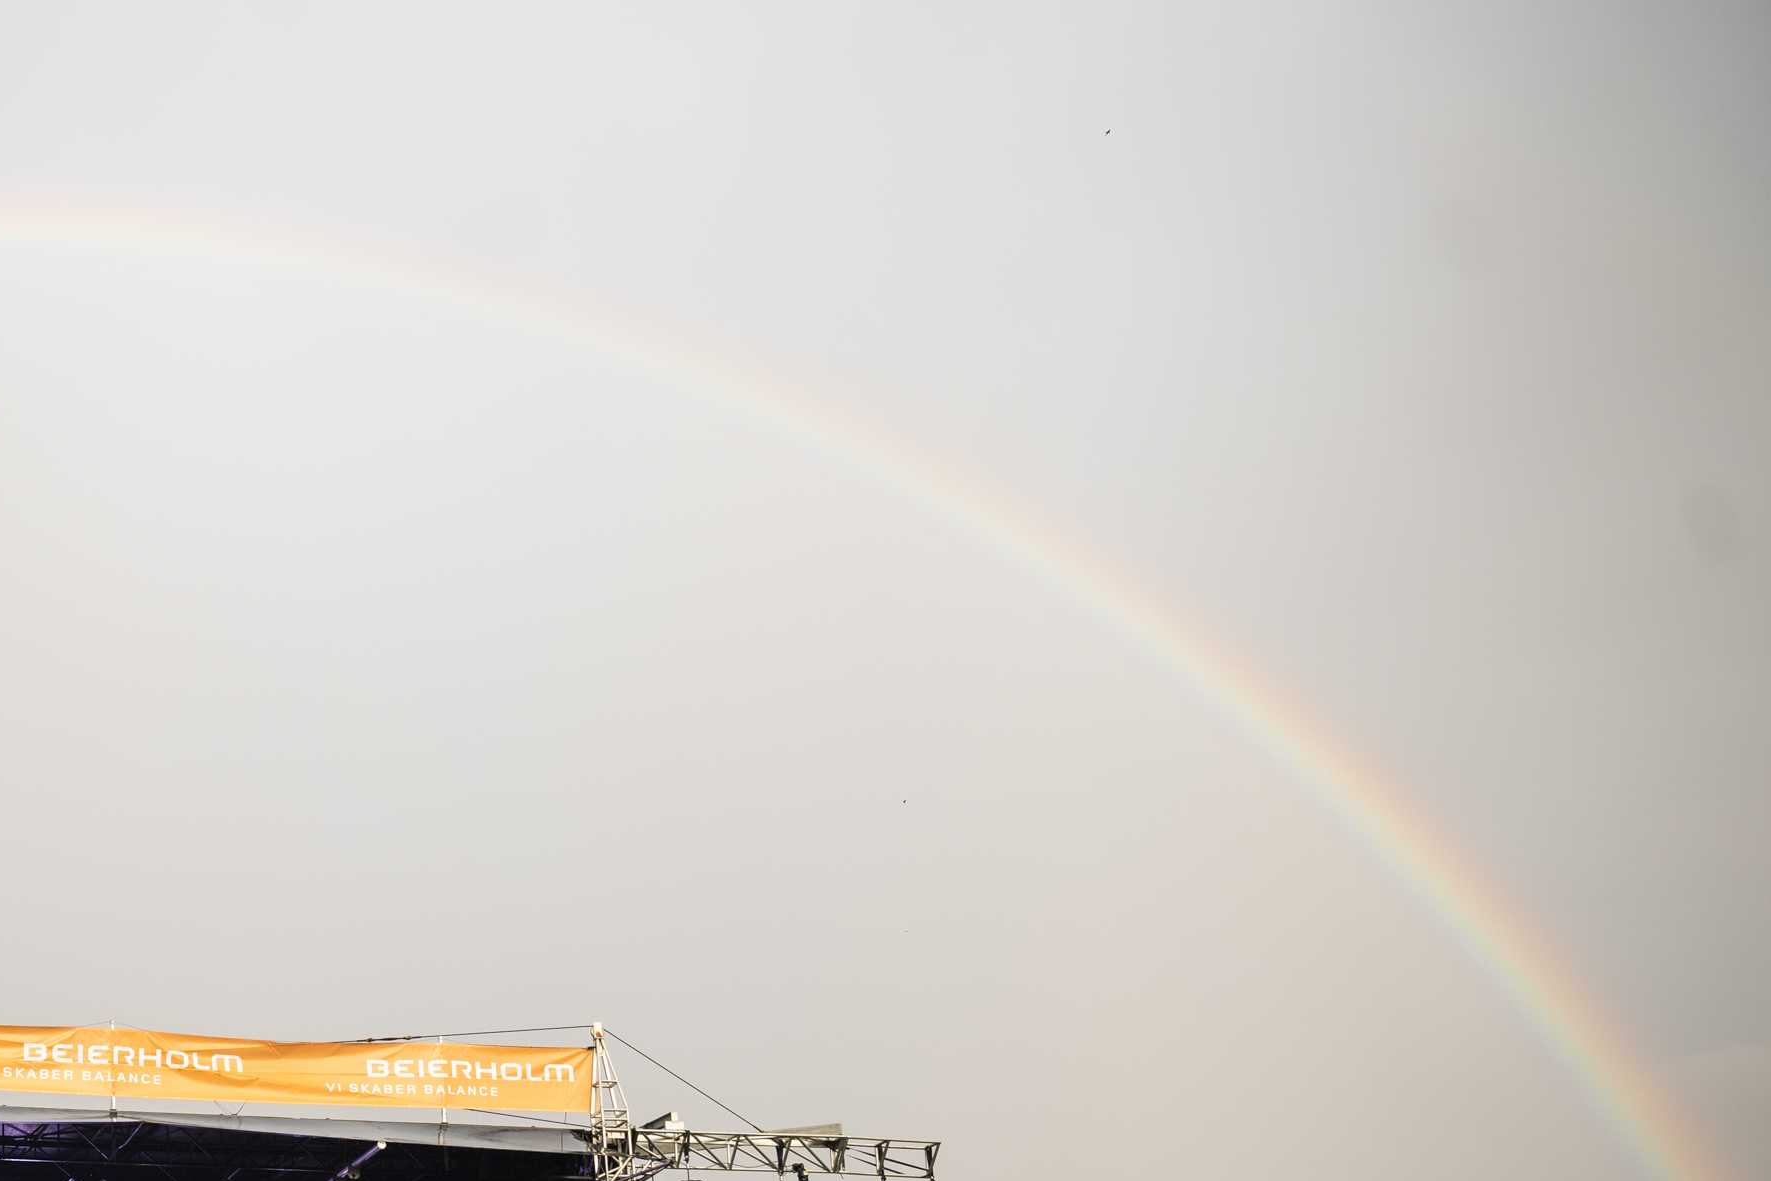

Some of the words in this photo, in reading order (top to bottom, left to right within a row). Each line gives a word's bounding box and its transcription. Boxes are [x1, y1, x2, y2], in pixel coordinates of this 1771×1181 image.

[23, 1042, 243, 1073] BEIERHOLM
[3, 1067, 74, 1081] SKABER
[82, 1070, 162, 1085] BALANCE
[366, 1059, 574, 1082] BEIERHOLM
[325, 1082, 342, 1093] VI
[349, 1083, 416, 1095] SKABER
[424, 1085, 499, 1097] BALANCE
